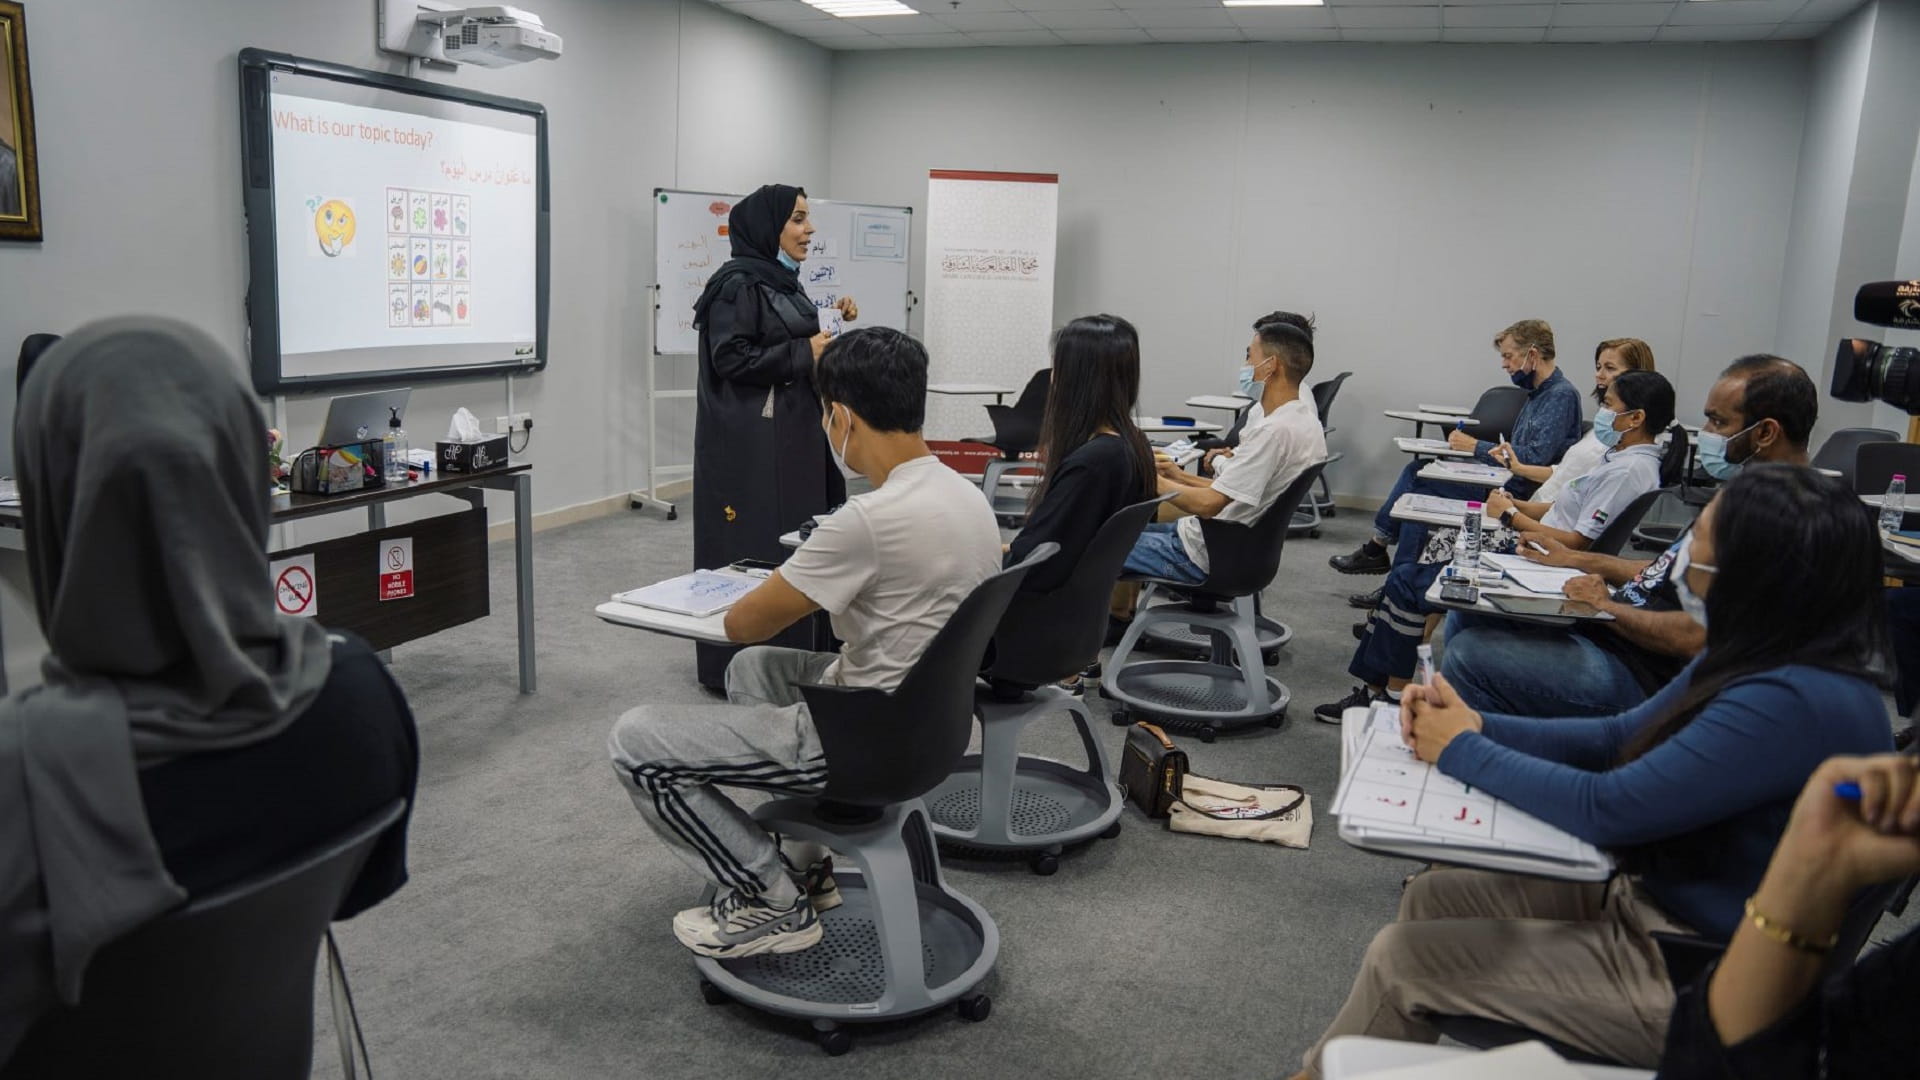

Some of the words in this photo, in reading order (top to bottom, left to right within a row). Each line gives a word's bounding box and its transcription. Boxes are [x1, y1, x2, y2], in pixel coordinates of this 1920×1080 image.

[273, 110, 314, 134] What
[318, 116, 329, 135] is
[331, 121, 356, 137] our
[359, 122, 391, 144] topic
[394, 127, 433, 150] today?
[279, 580, 308, 594] CHWING
